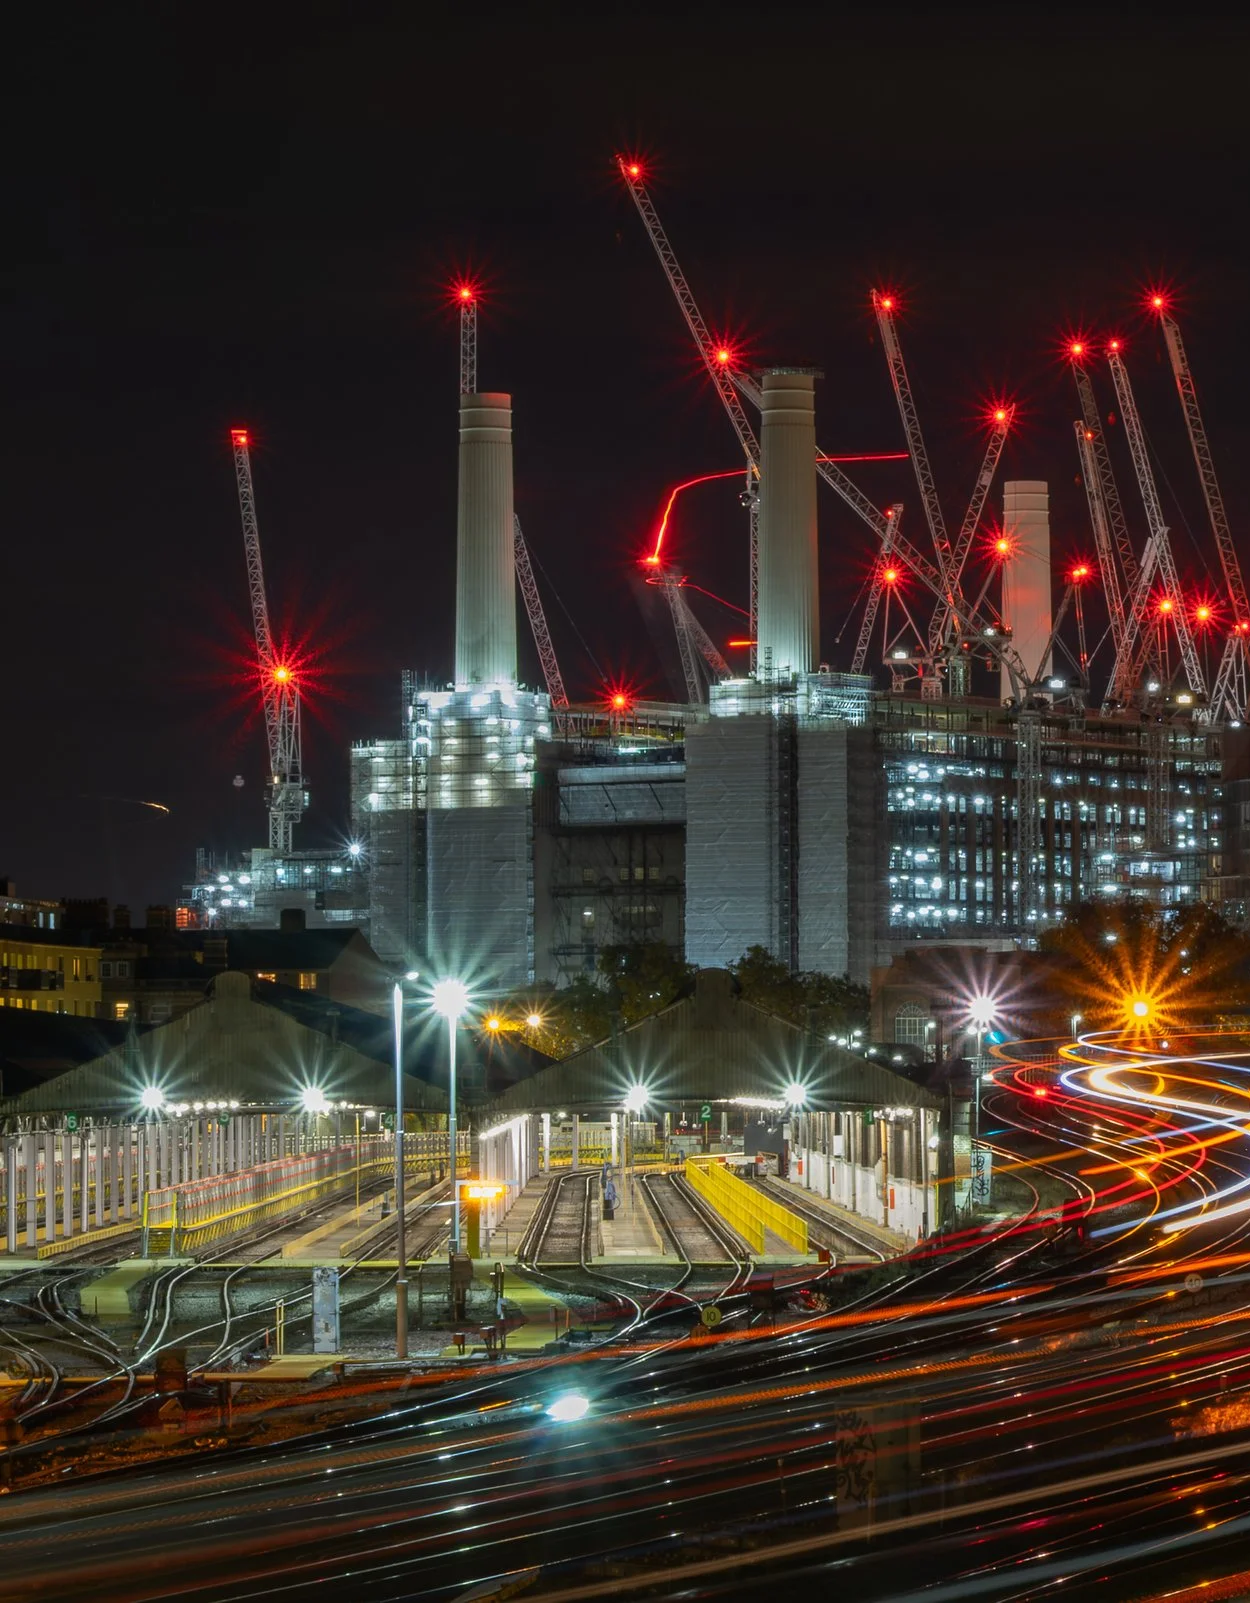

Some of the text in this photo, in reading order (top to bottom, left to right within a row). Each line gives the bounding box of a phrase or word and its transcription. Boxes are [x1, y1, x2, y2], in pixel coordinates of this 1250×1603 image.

[701, 1105, 711, 1118] 2
[866, 1109, 873, 1122] 1
[67, 1115, 77, 1129] 6
[385, 1114, 394, 1127] 4
[706, 1311, 716, 1322] 10
